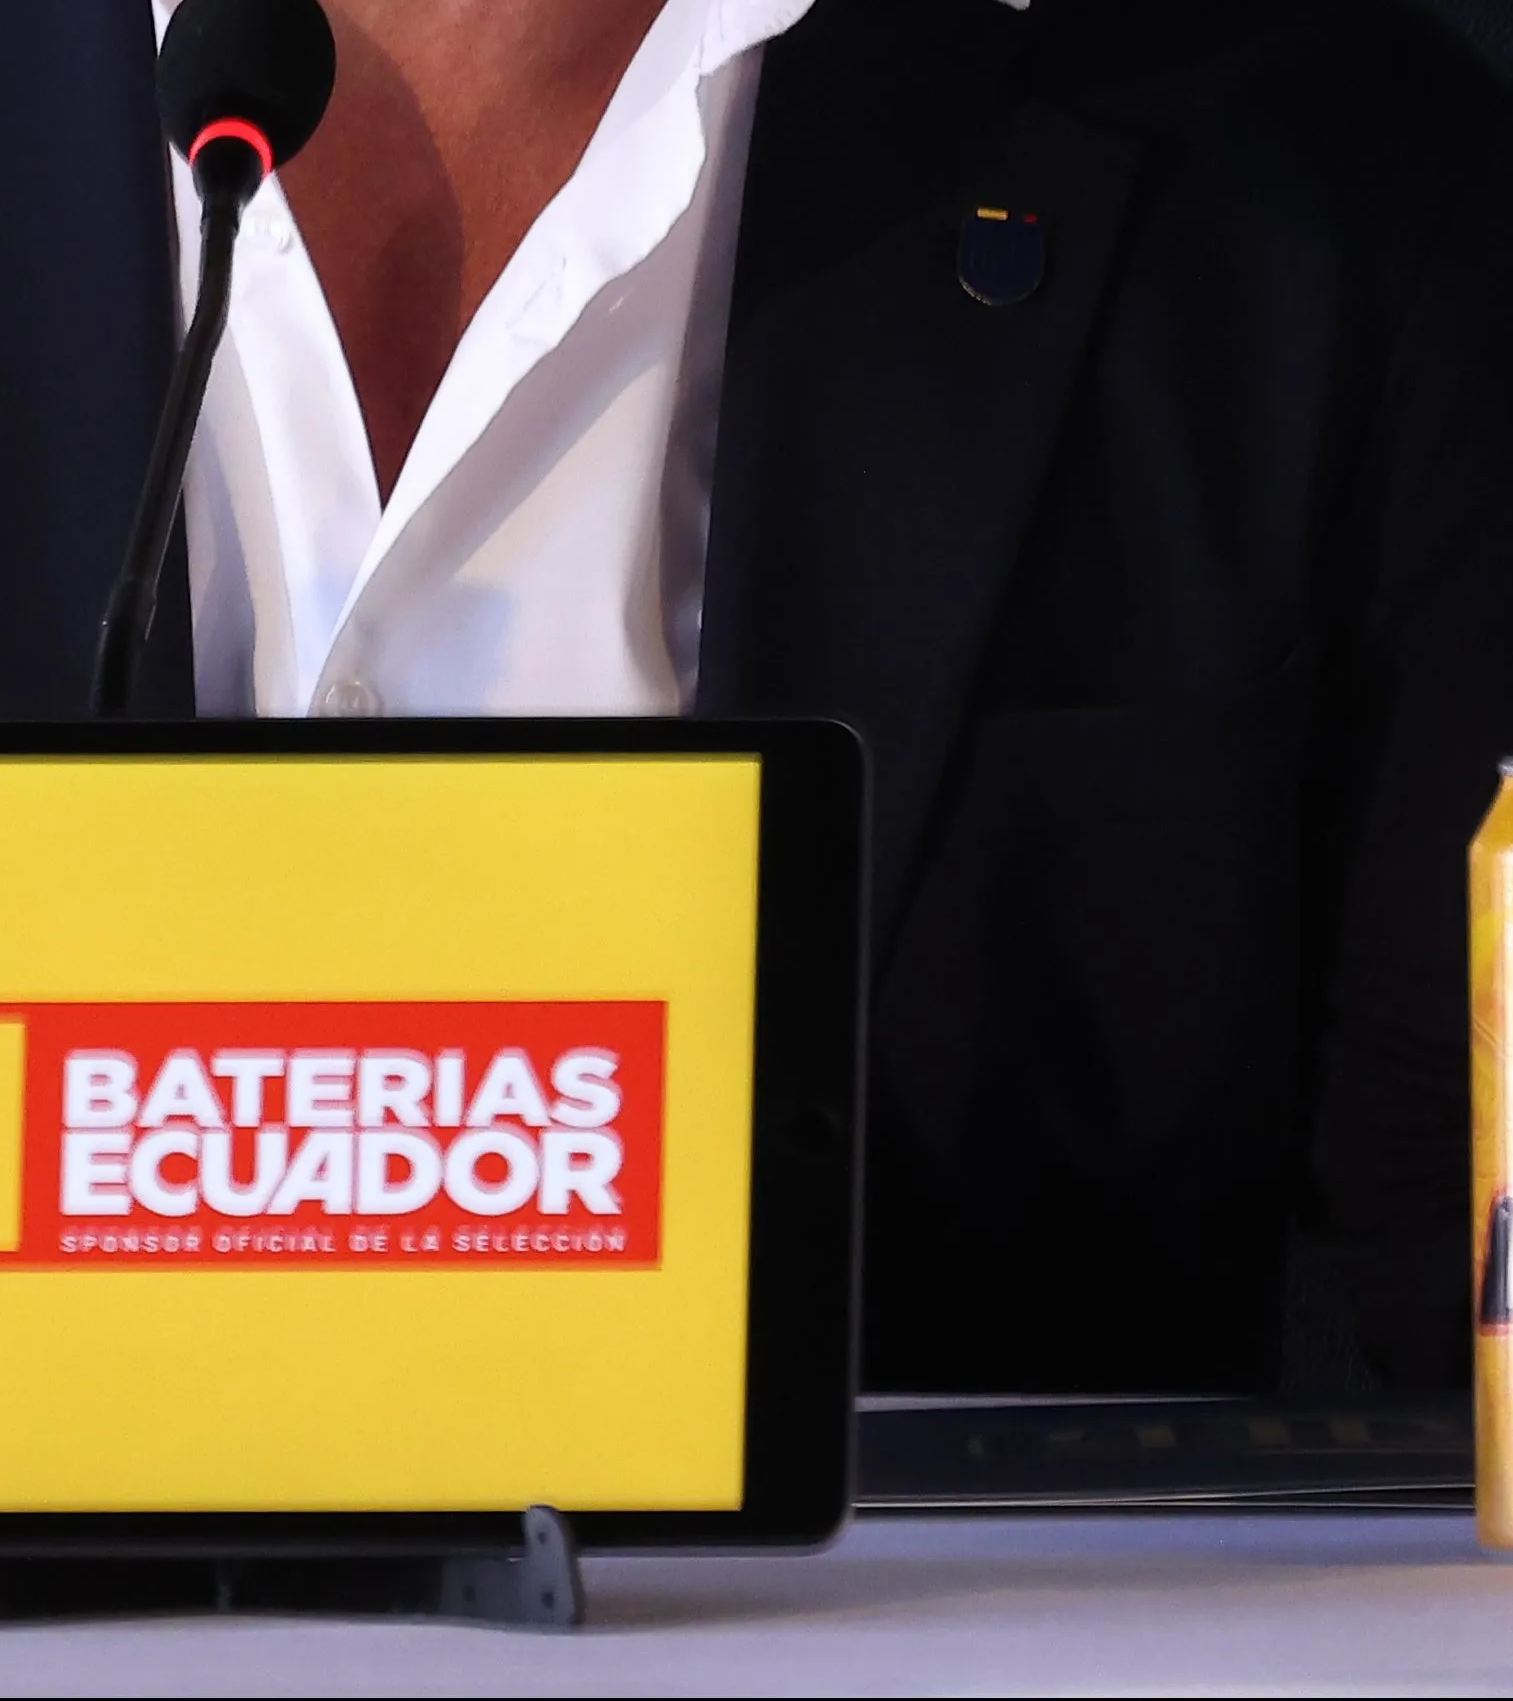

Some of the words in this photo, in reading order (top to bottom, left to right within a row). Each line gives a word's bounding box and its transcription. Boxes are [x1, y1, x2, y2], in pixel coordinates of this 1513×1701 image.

[64, 1048, 622, 1128] BATERIAS
[60, 1123, 624, 1217] ECUADOR
[60, 1229, 201, 1254] SPONSOR
[212, 1229, 335, 1254] OFICIAL
[350, 1229, 389, 1254] DE
[401, 1229, 440, 1254] LA
